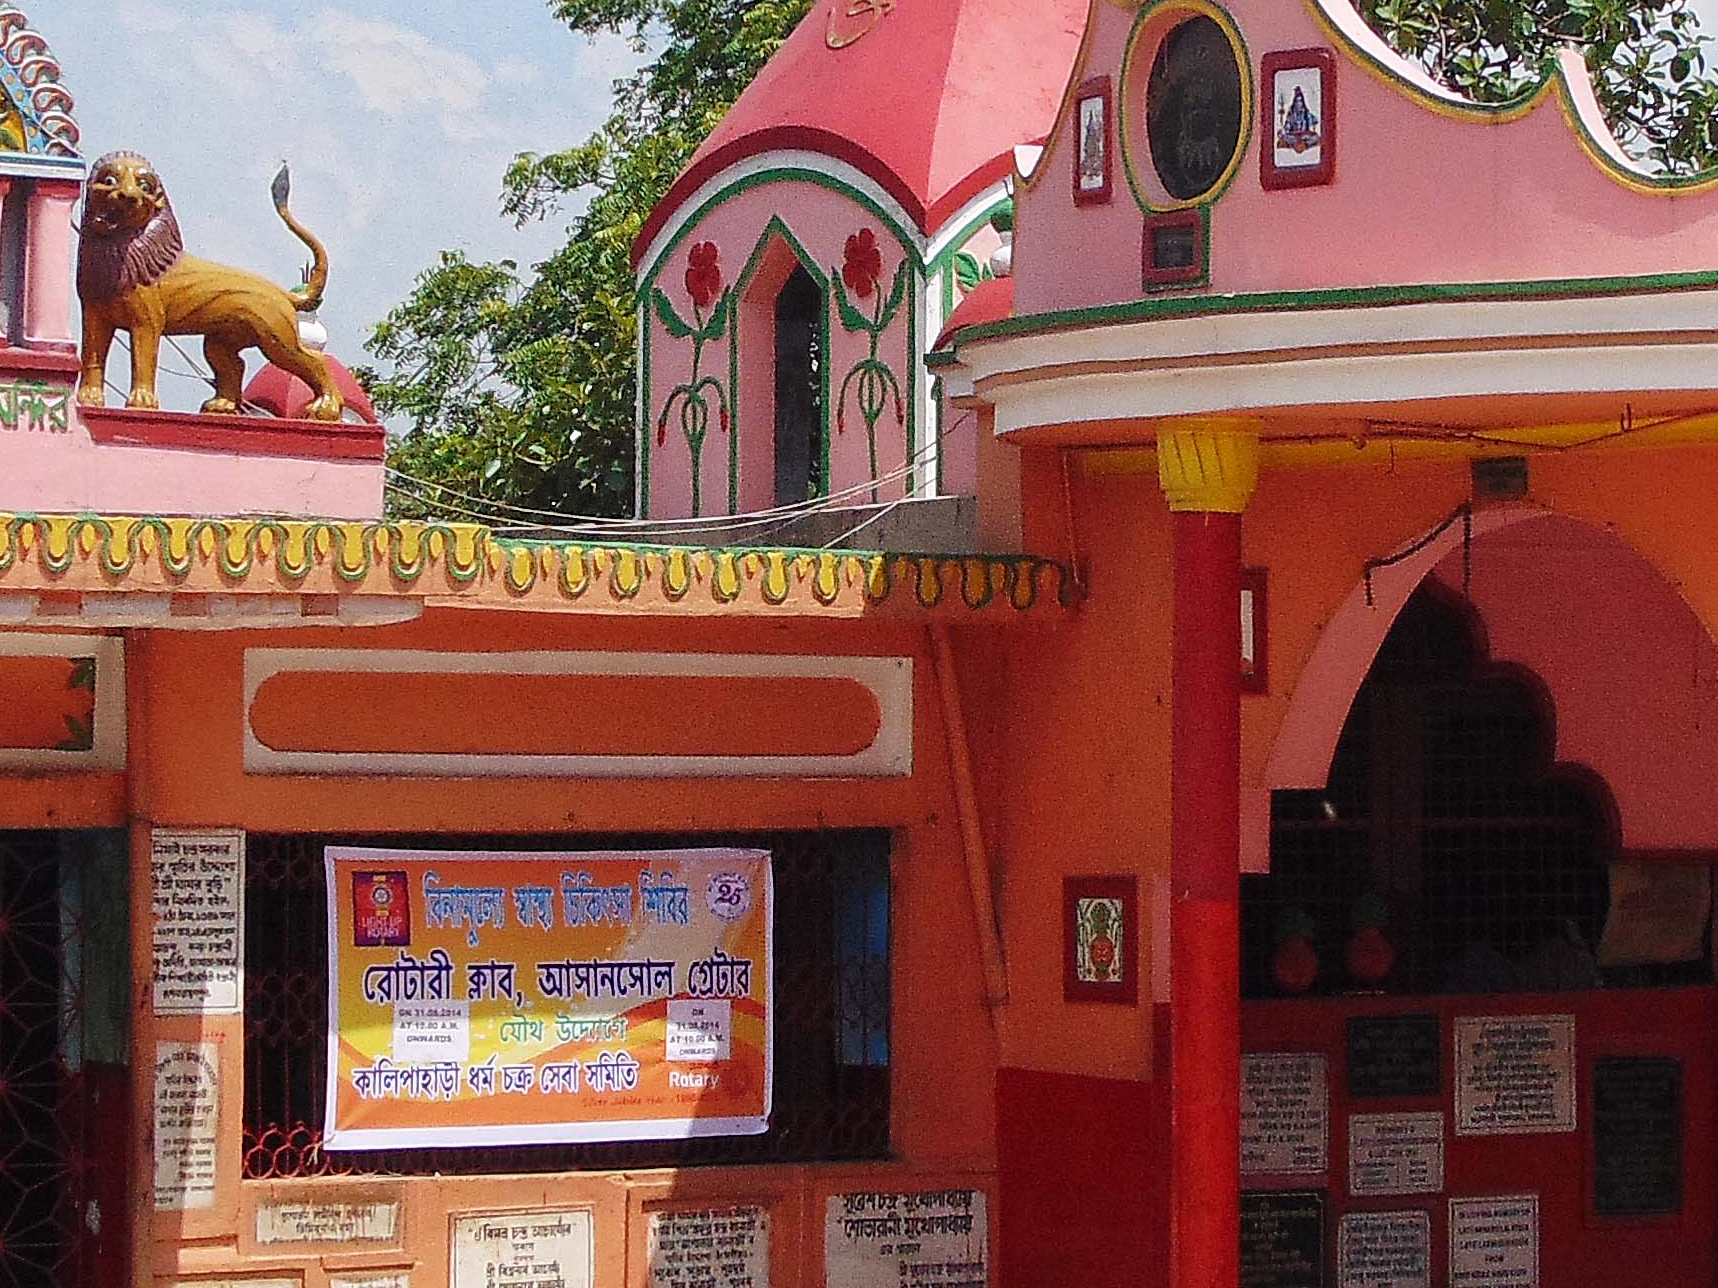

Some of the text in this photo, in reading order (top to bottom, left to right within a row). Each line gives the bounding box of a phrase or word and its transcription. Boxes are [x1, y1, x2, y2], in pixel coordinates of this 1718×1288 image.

[638, 870, 691, 926] শিবির
[362, 948, 454, 1004] রোটারী
[537, 958, 675, 999] আসানসোল
[687, 946, 752, 999] গ্রেটার
[499, 1016, 543, 1043] যৌথ
[467, 1054, 496, 1096] ধর্ম
[502, 1064, 535, 1093] চক্র
[540, 1061, 579, 1091] সেবা
[585, 1051, 640, 1095] সমিতি
[668, 1071, 720, 1089] Rotary
